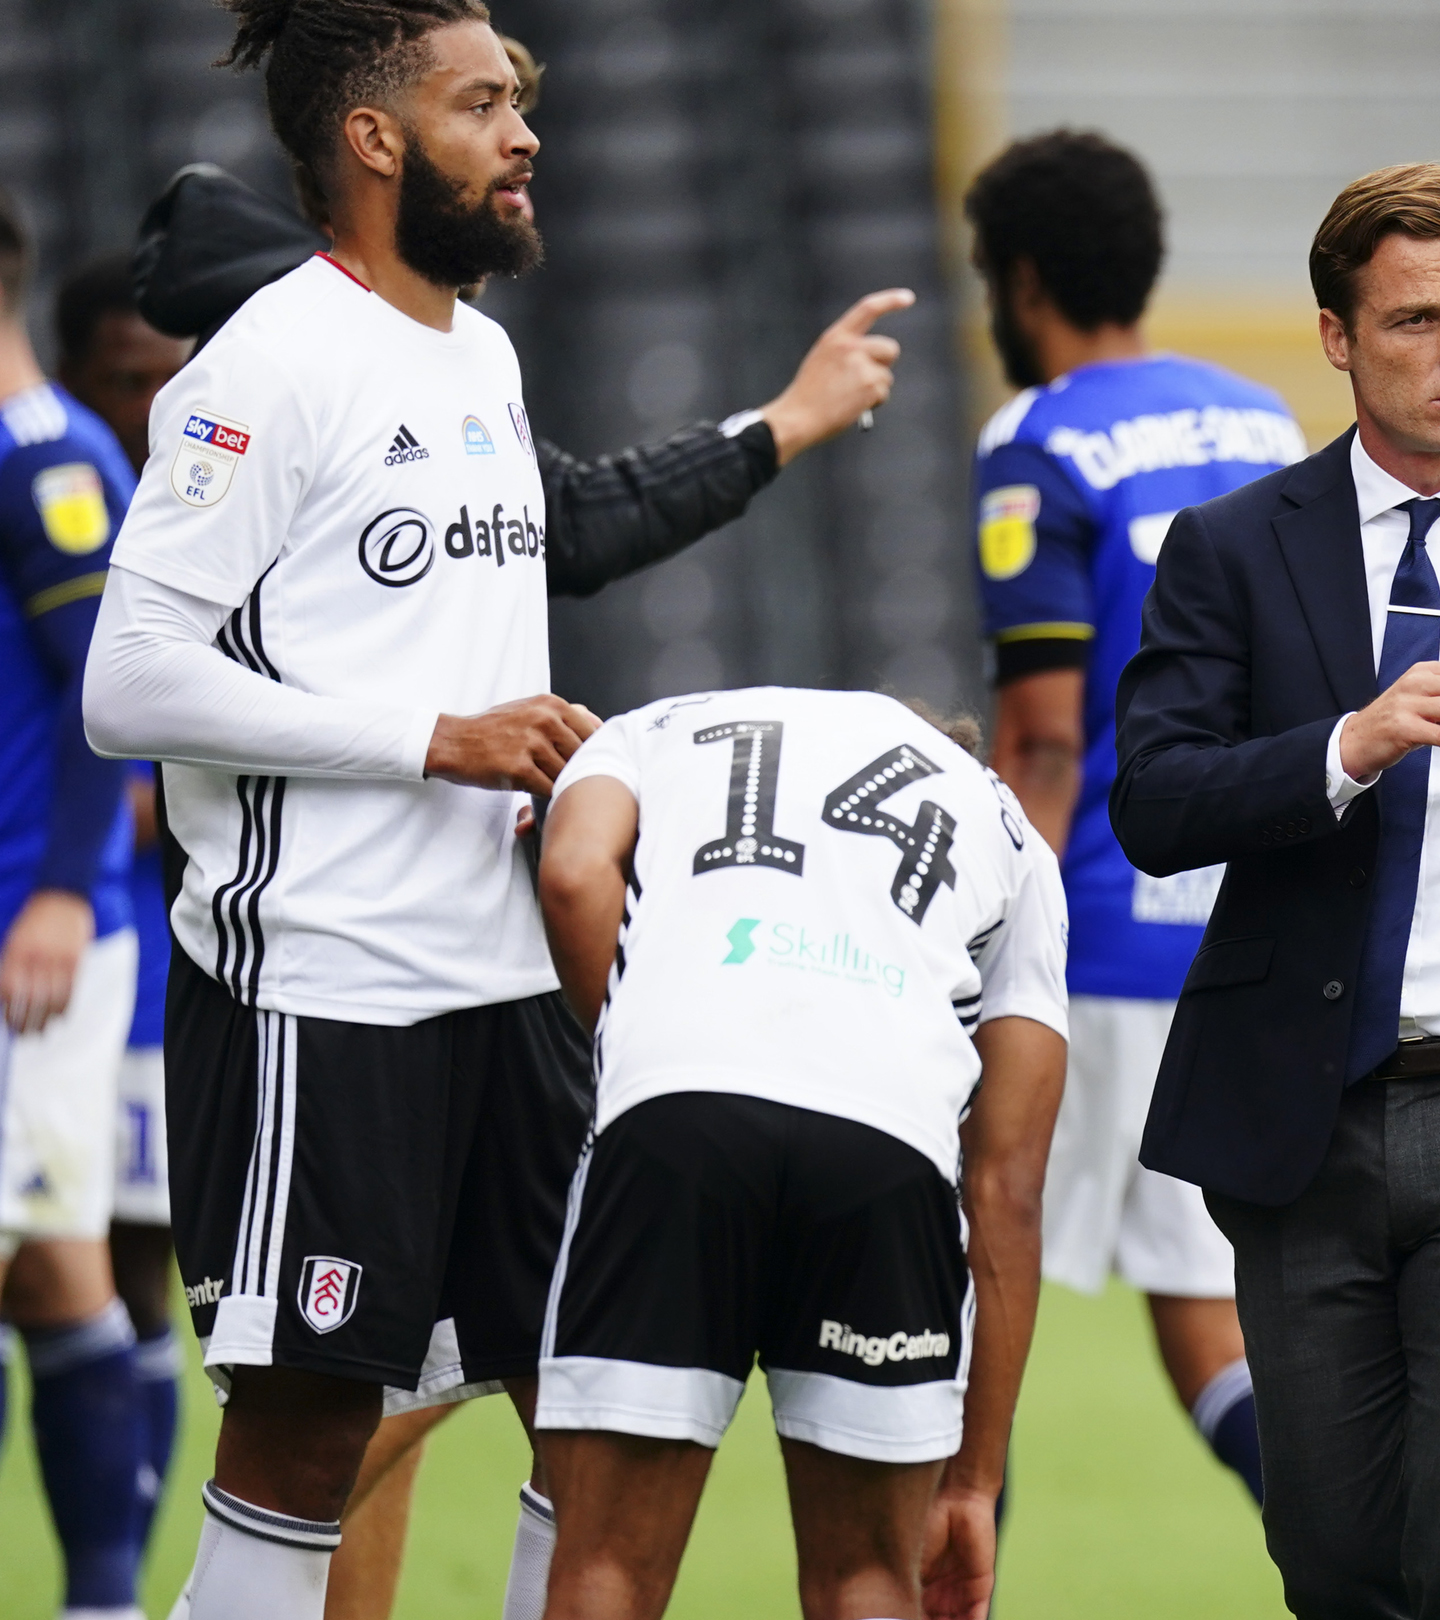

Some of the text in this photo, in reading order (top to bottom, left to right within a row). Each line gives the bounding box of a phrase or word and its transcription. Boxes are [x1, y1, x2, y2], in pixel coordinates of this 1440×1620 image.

[186, 417, 247, 450] sky bet
[384, 447, 430, 467] adidas
[186, 485, 206, 500] EFL
[692, 720, 959, 928] 14
[769, 922, 905, 998] Skilling
[313, 1268, 344, 1316] FFC
